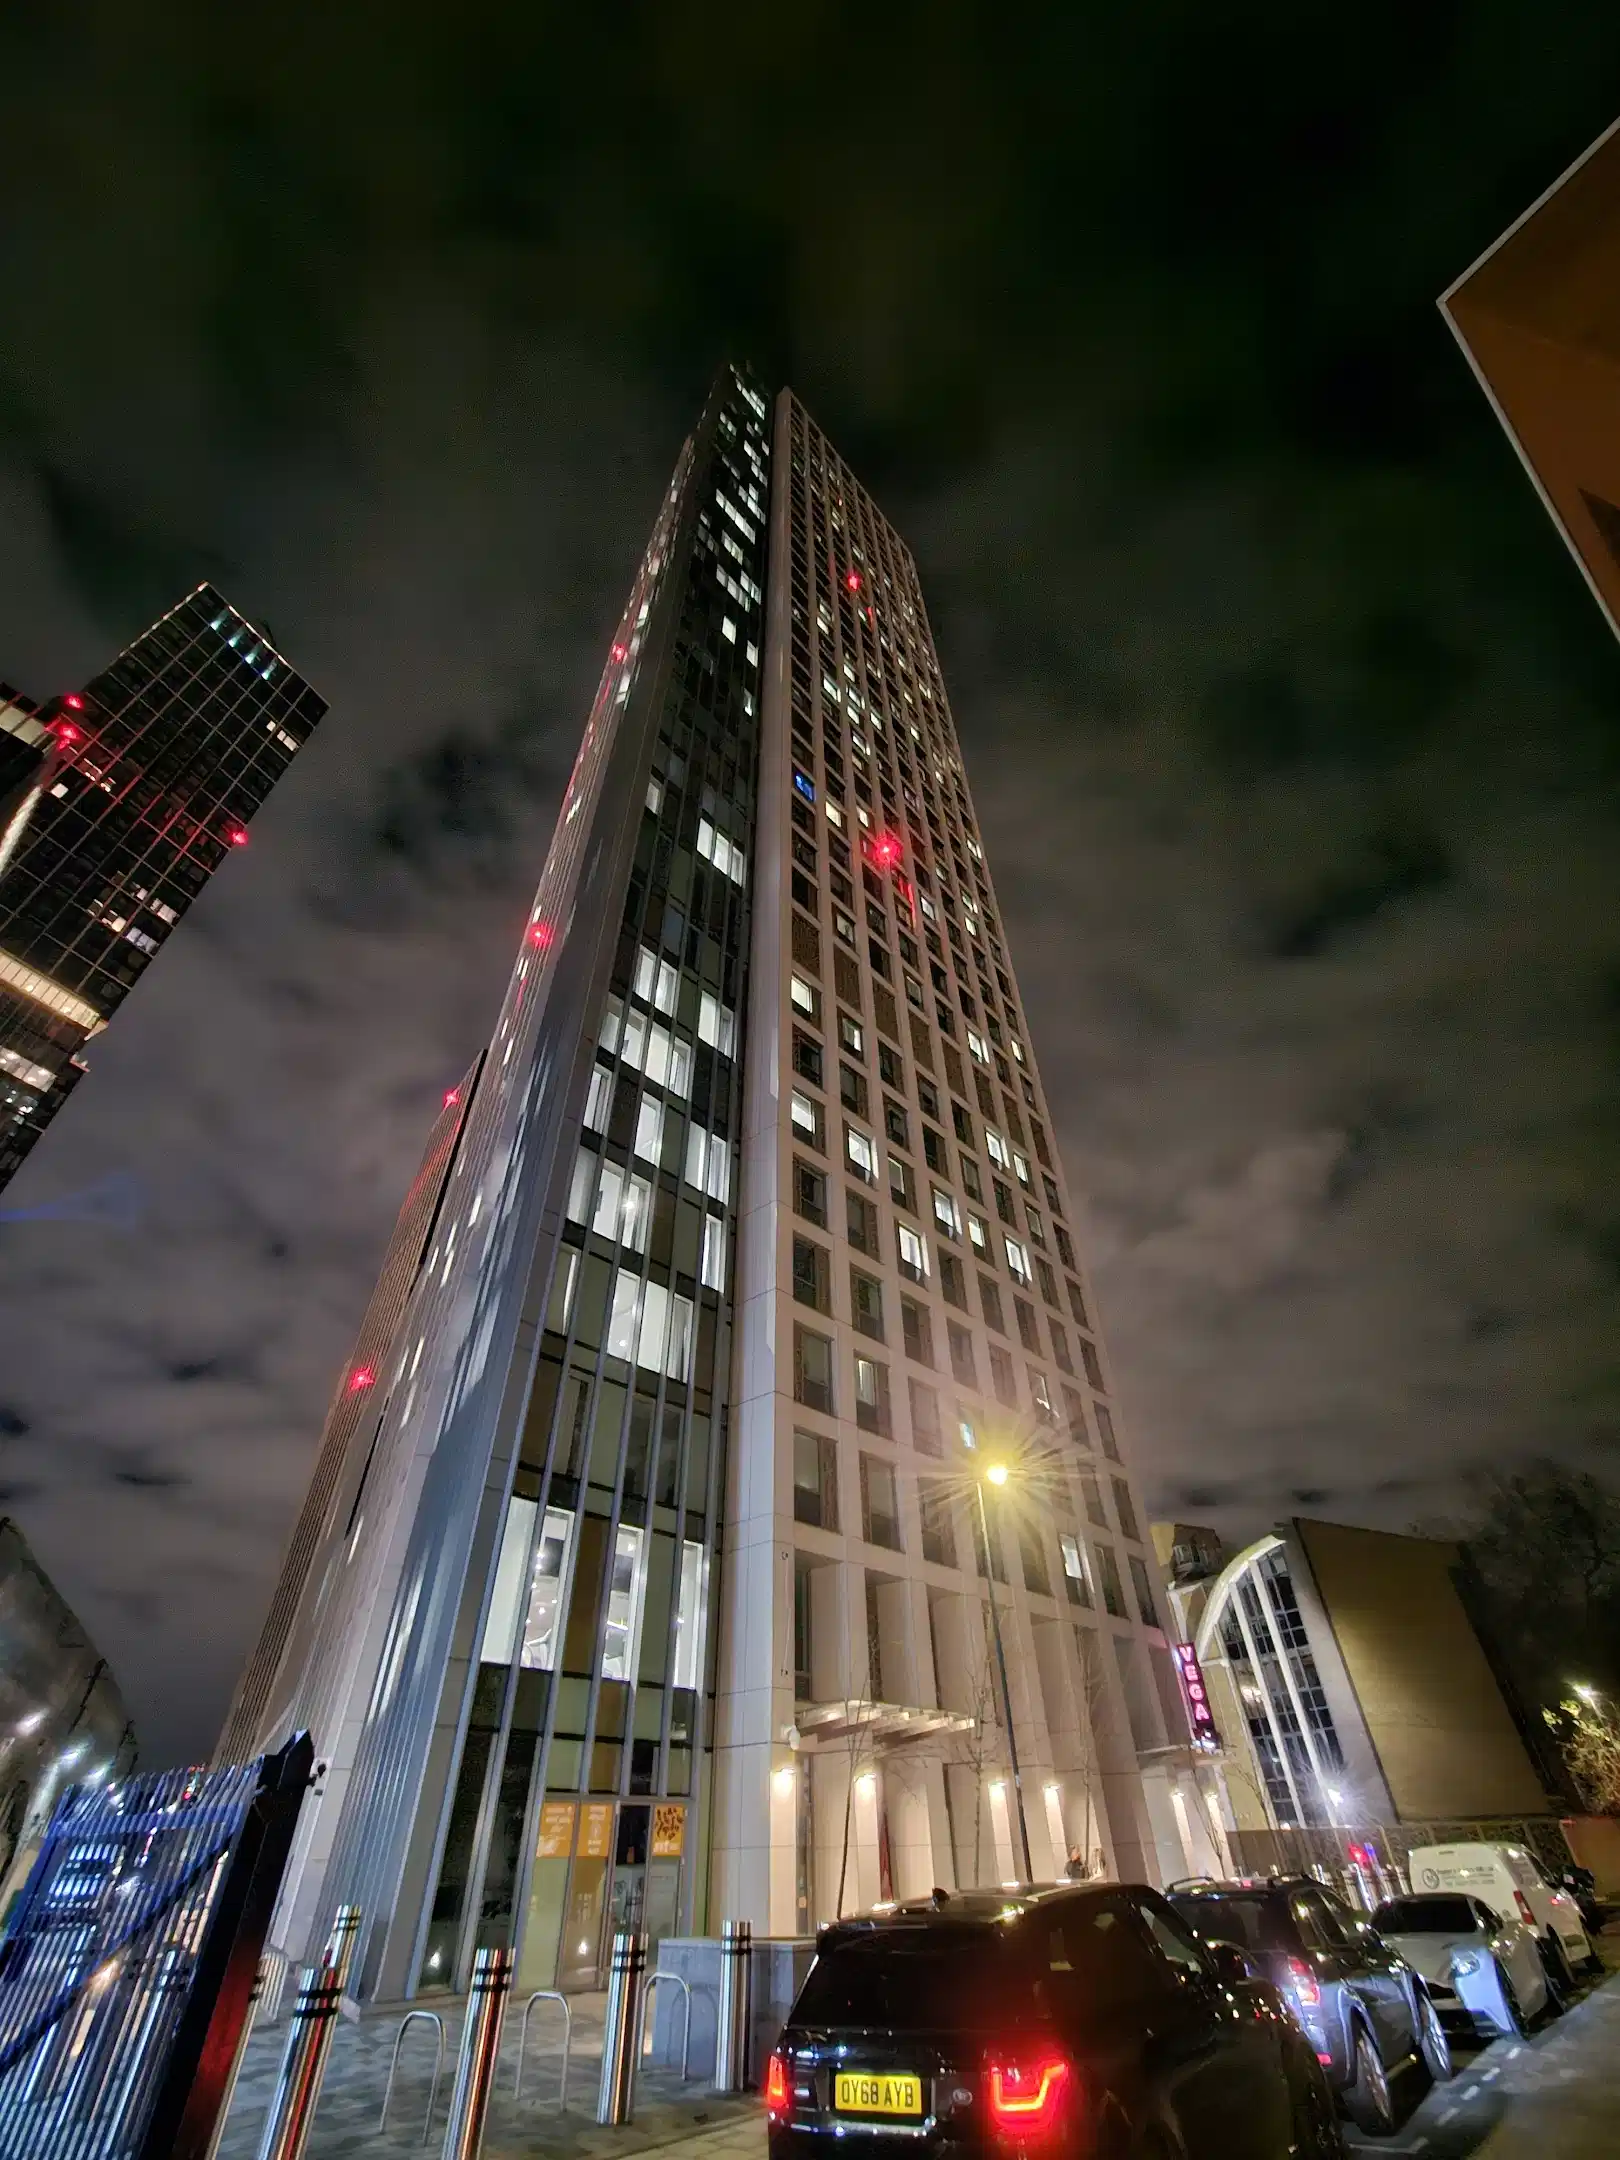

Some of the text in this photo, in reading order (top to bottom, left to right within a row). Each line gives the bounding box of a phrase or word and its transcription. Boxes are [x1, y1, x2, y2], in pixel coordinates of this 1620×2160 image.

[1178, 1646, 1210, 1721] VEGA
[841, 2079, 914, 2108] OY68 AYB
